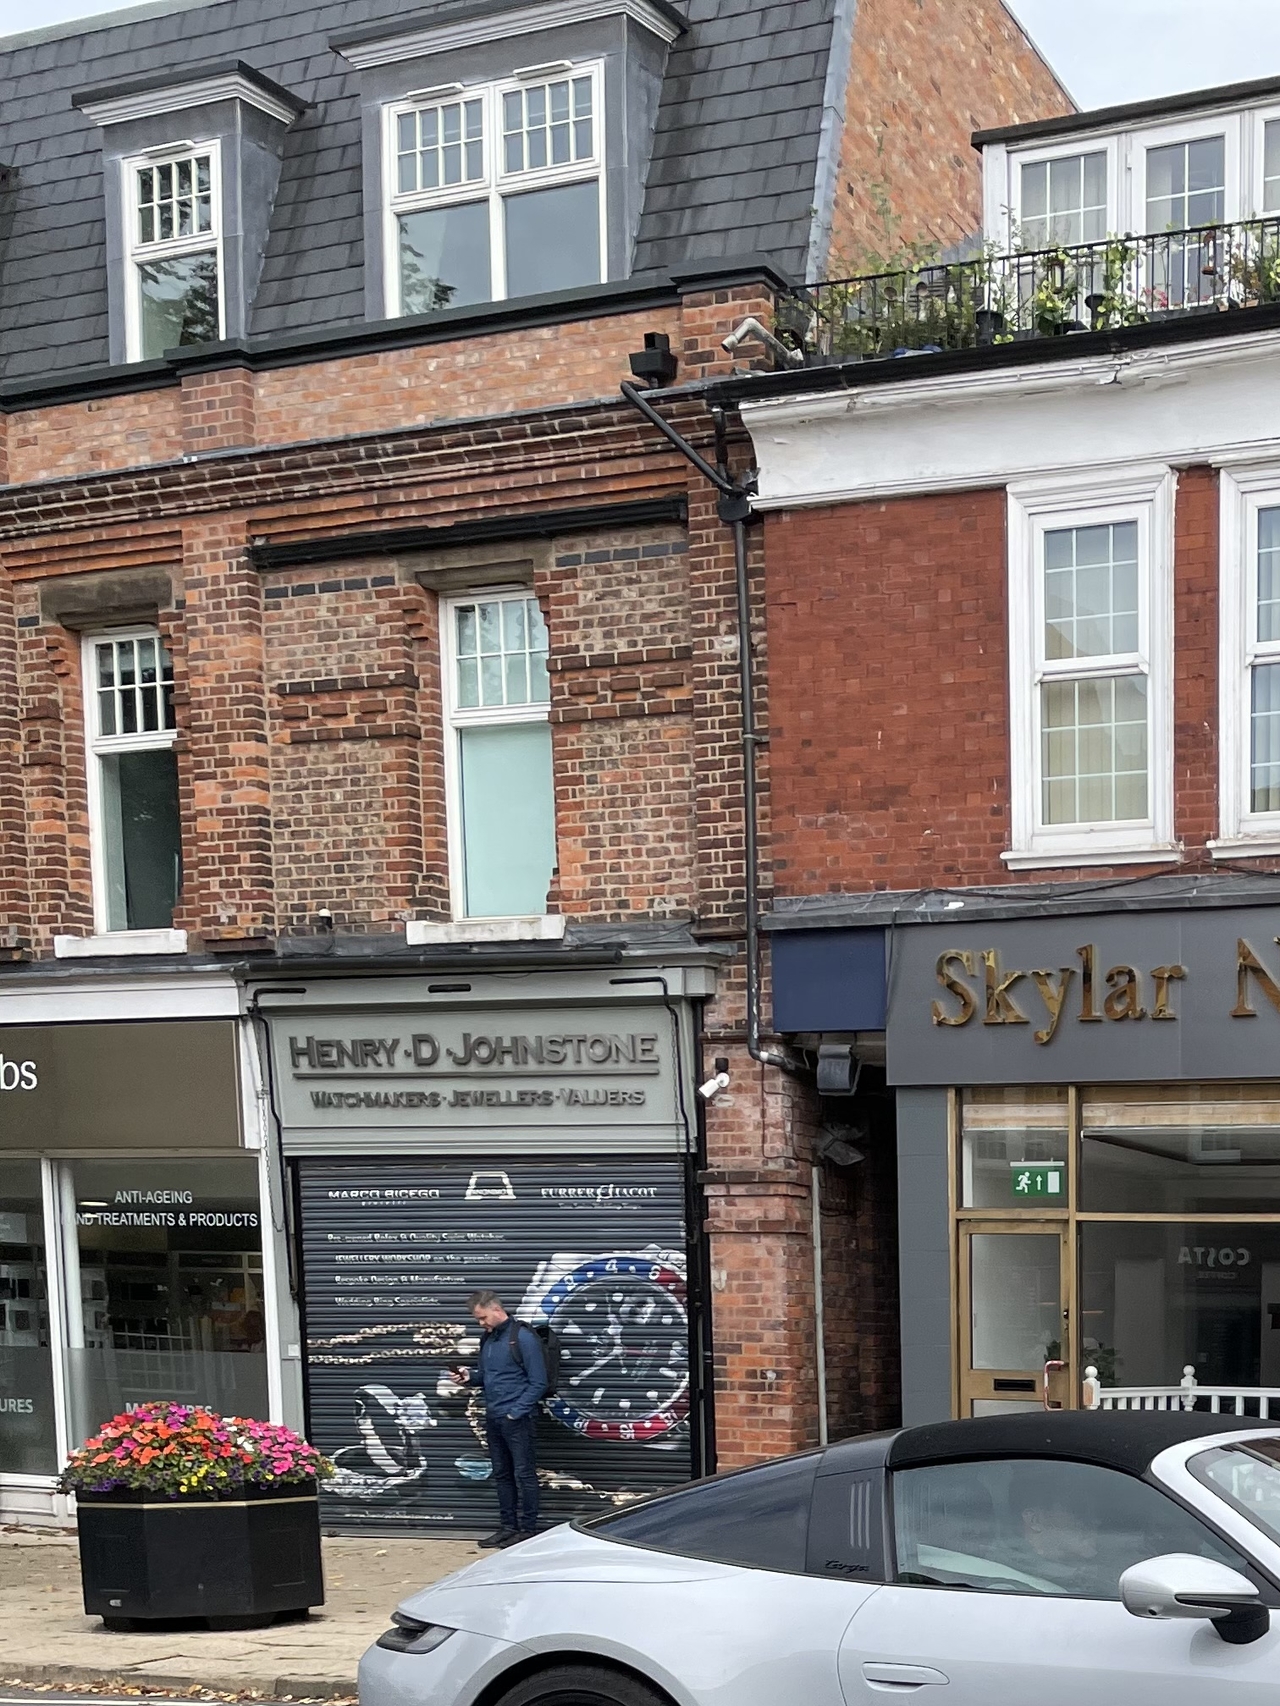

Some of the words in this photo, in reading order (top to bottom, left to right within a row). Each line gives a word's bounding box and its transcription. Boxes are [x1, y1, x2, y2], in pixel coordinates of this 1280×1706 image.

[932, 943, 1187, 1046] Skylar
[289, 1035, 400, 1068] HENRY
[450, 1033, 660, 1066] JOHNSTONE
[0, 1053, 38, 1090] bs
[559, 1087, 645, 1107] VALUERS
[115, 1190, 193, 1204] ANTI-AGEING
[96, 1212, 175, 1227] TREATMENTS
[178, 1213, 187, 1227] &
[189, 1212, 258, 1227] PRODUCTS
[825, 1559, 870, 1574] Targa
